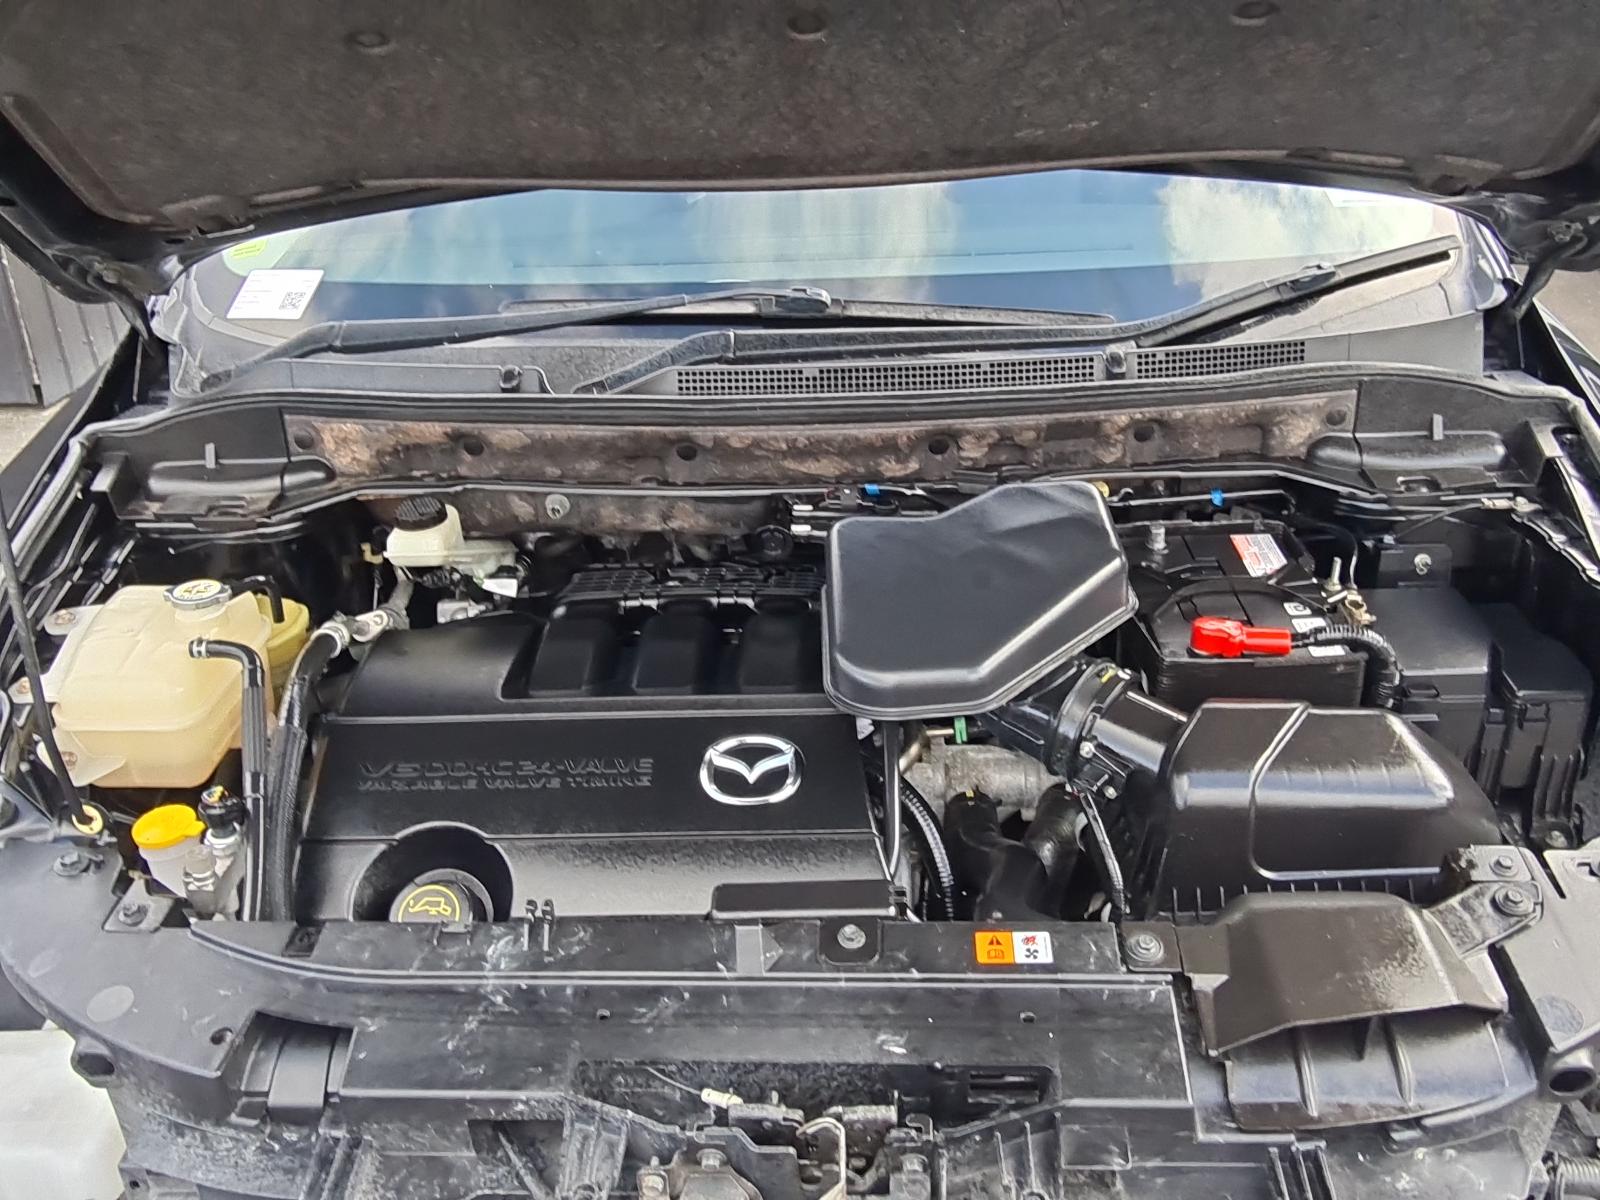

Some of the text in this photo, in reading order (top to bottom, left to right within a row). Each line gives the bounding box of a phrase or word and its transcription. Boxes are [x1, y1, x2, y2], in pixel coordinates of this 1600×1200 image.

[358, 775, 653, 792] VARIABLE VALVE TIMING
